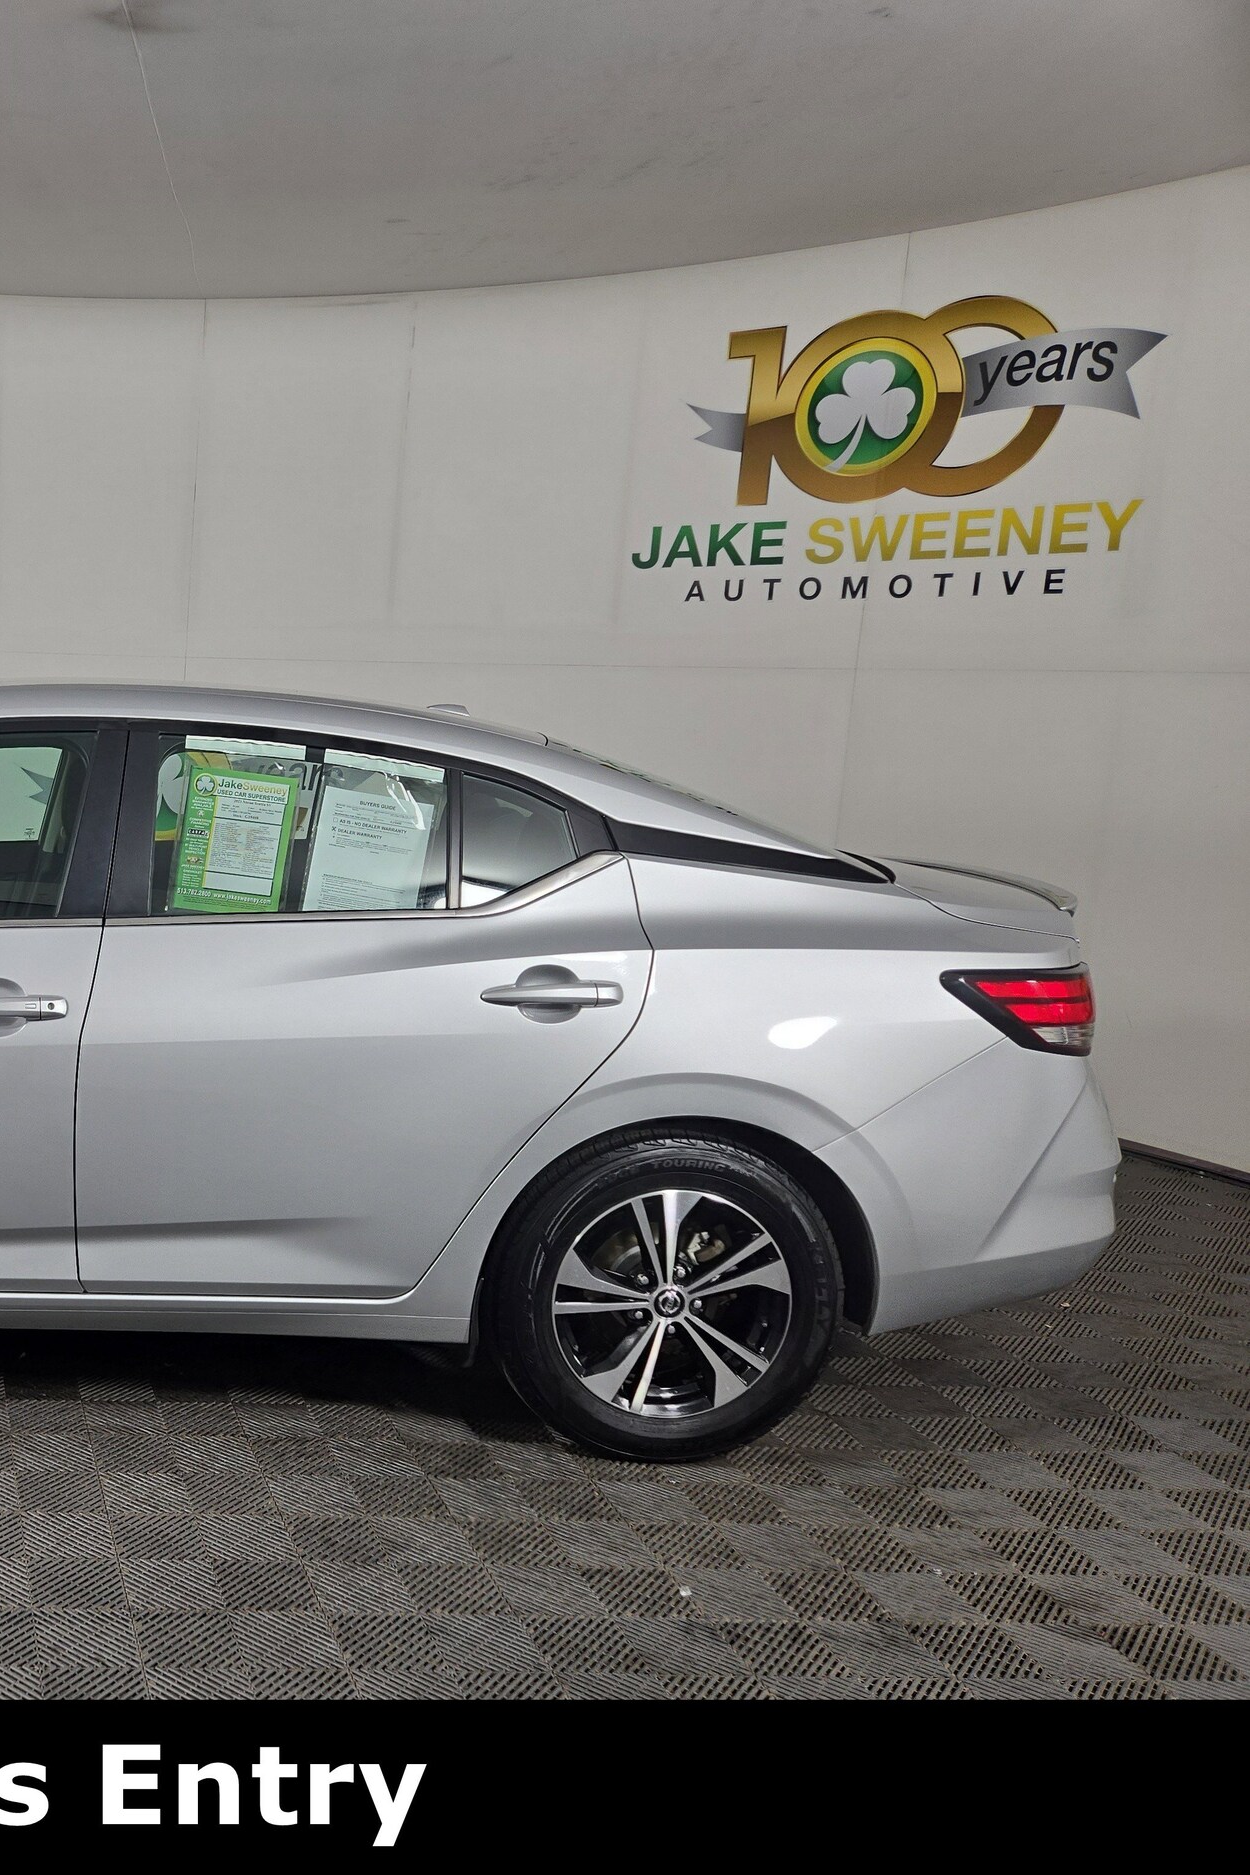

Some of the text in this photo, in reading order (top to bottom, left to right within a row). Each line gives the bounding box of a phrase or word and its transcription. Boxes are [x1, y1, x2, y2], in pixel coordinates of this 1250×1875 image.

[973, 339, 1117, 406] years
[632, 499, 1146, 569] JAKE SWEENEY
[684, 568, 1066, 602] AUTOMOTIVE
[217, 788, 234, 796] USED
[248, 793, 287, 803] SUPERSTORE
[381, 803, 396, 811] GUIDE
[337, 828, 383, 840] DEALER WARRANTY
[362, 822, 381, 830] DEALER
[381, 825, 407, 834] WARRANTY
